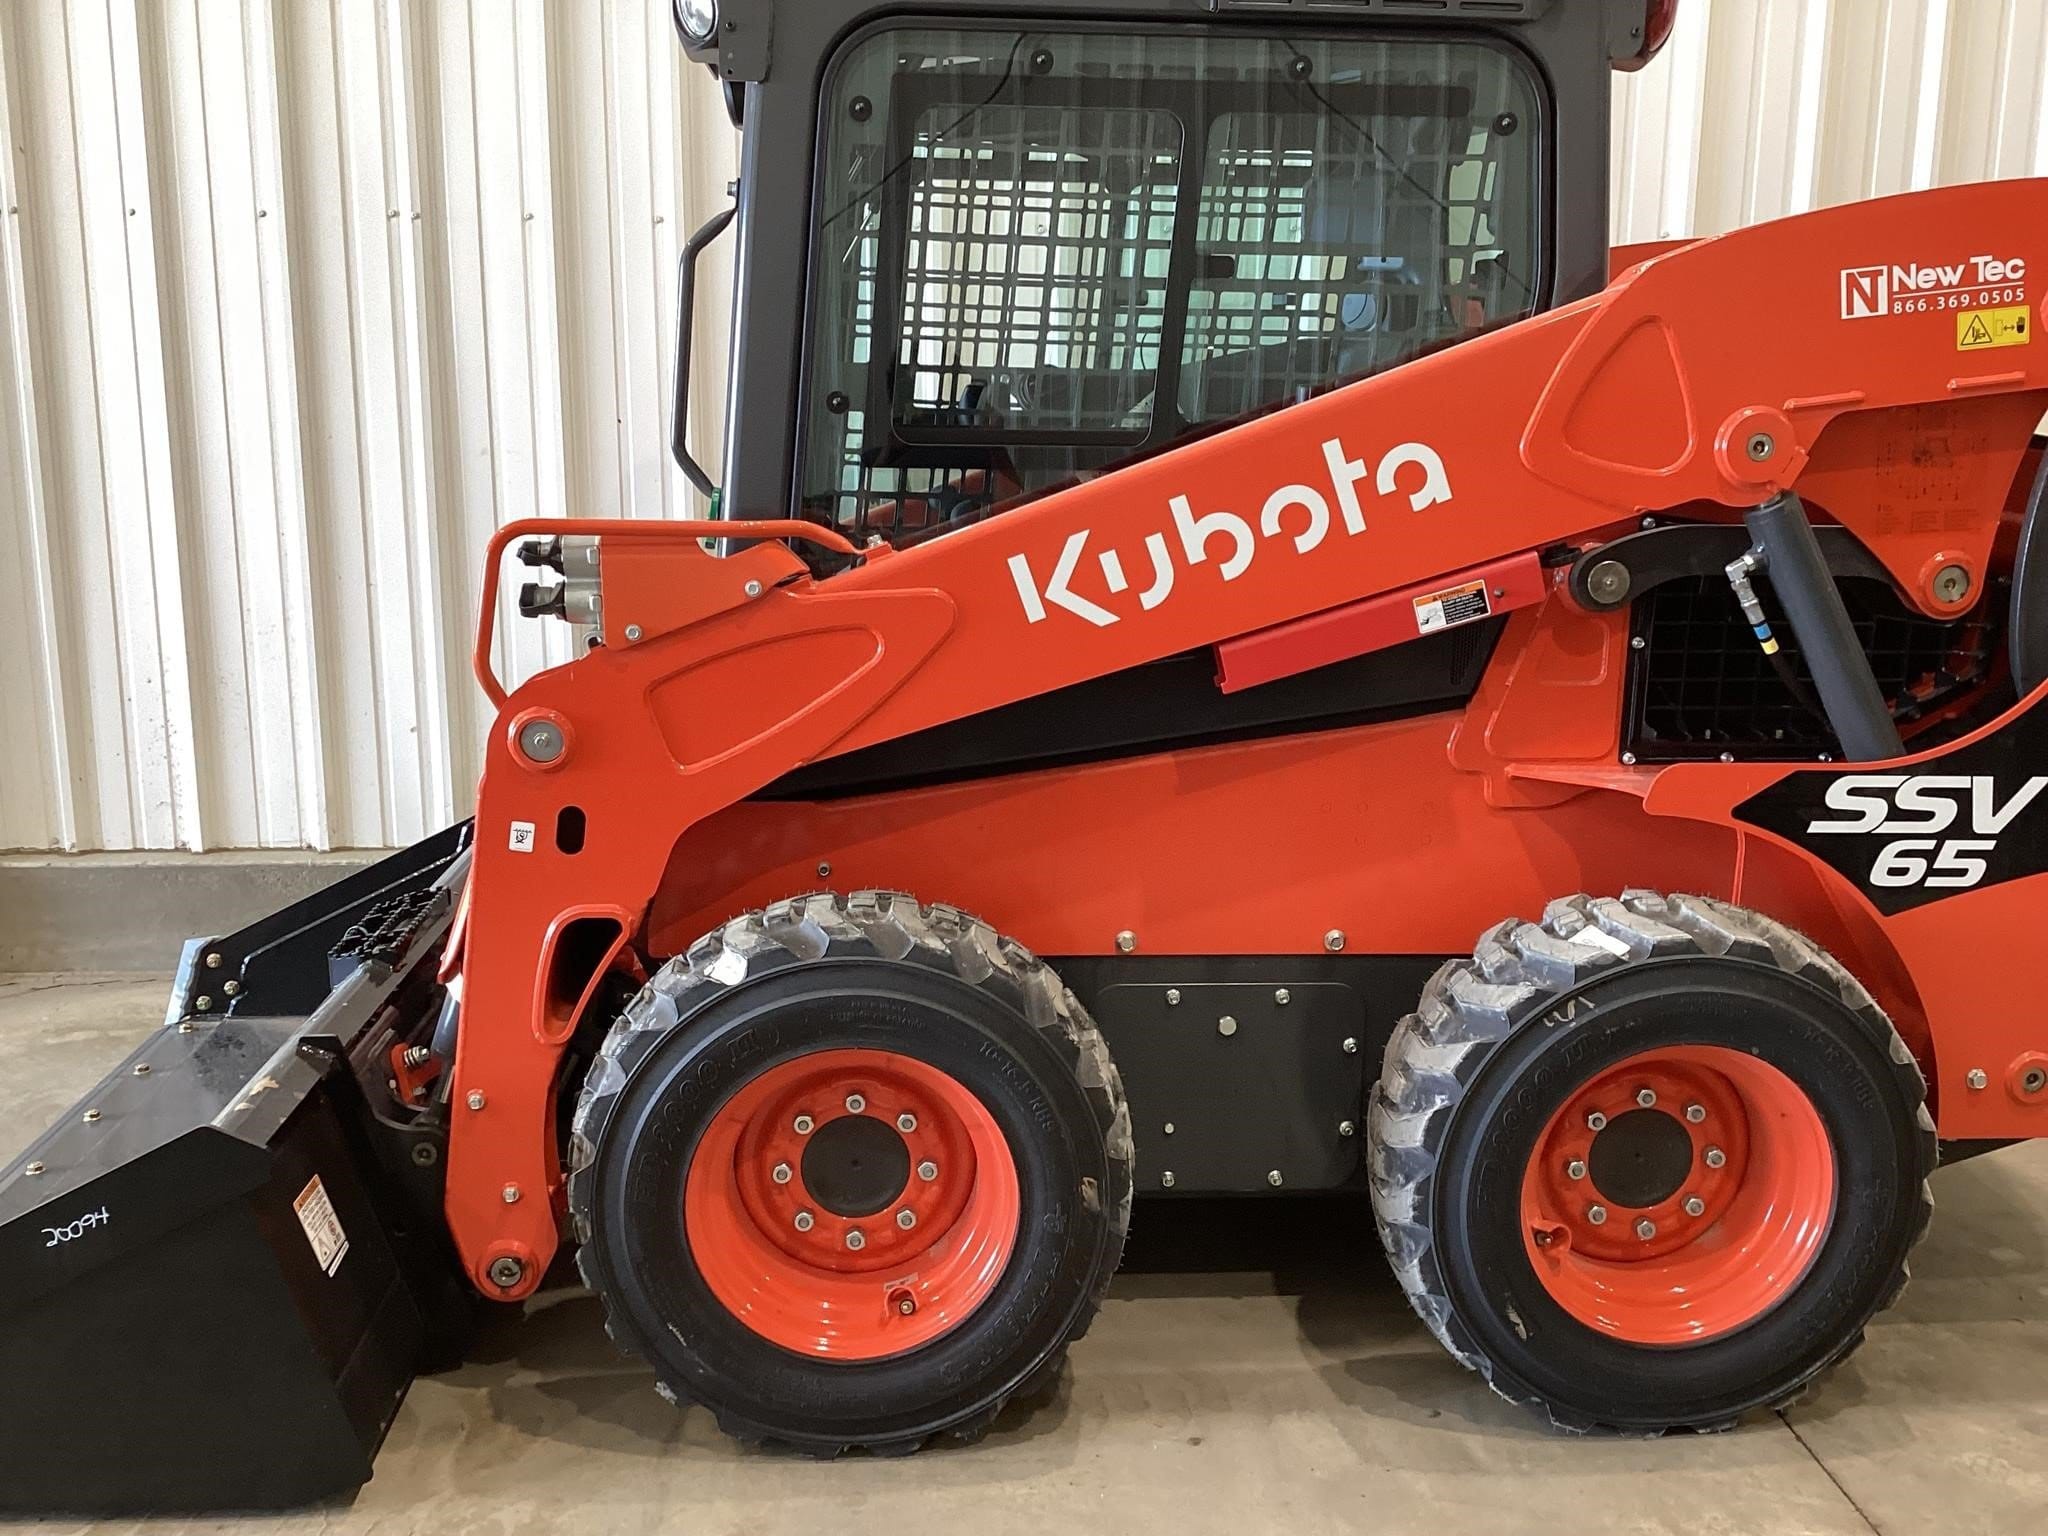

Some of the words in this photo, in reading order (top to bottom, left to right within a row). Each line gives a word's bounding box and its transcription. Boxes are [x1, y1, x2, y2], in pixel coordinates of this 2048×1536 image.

[1892, 263, 1966, 292] New
[1969, 254, 2026, 283] Tec
[1893, 288, 2026, 315] 866.369.0505
[1007, 437, 1453, 627] Kubota
[1806, 775, 2048, 835] SSV
[1869, 839, 1998, 888] 65
[41, 1206, 110, 1247] 20094
